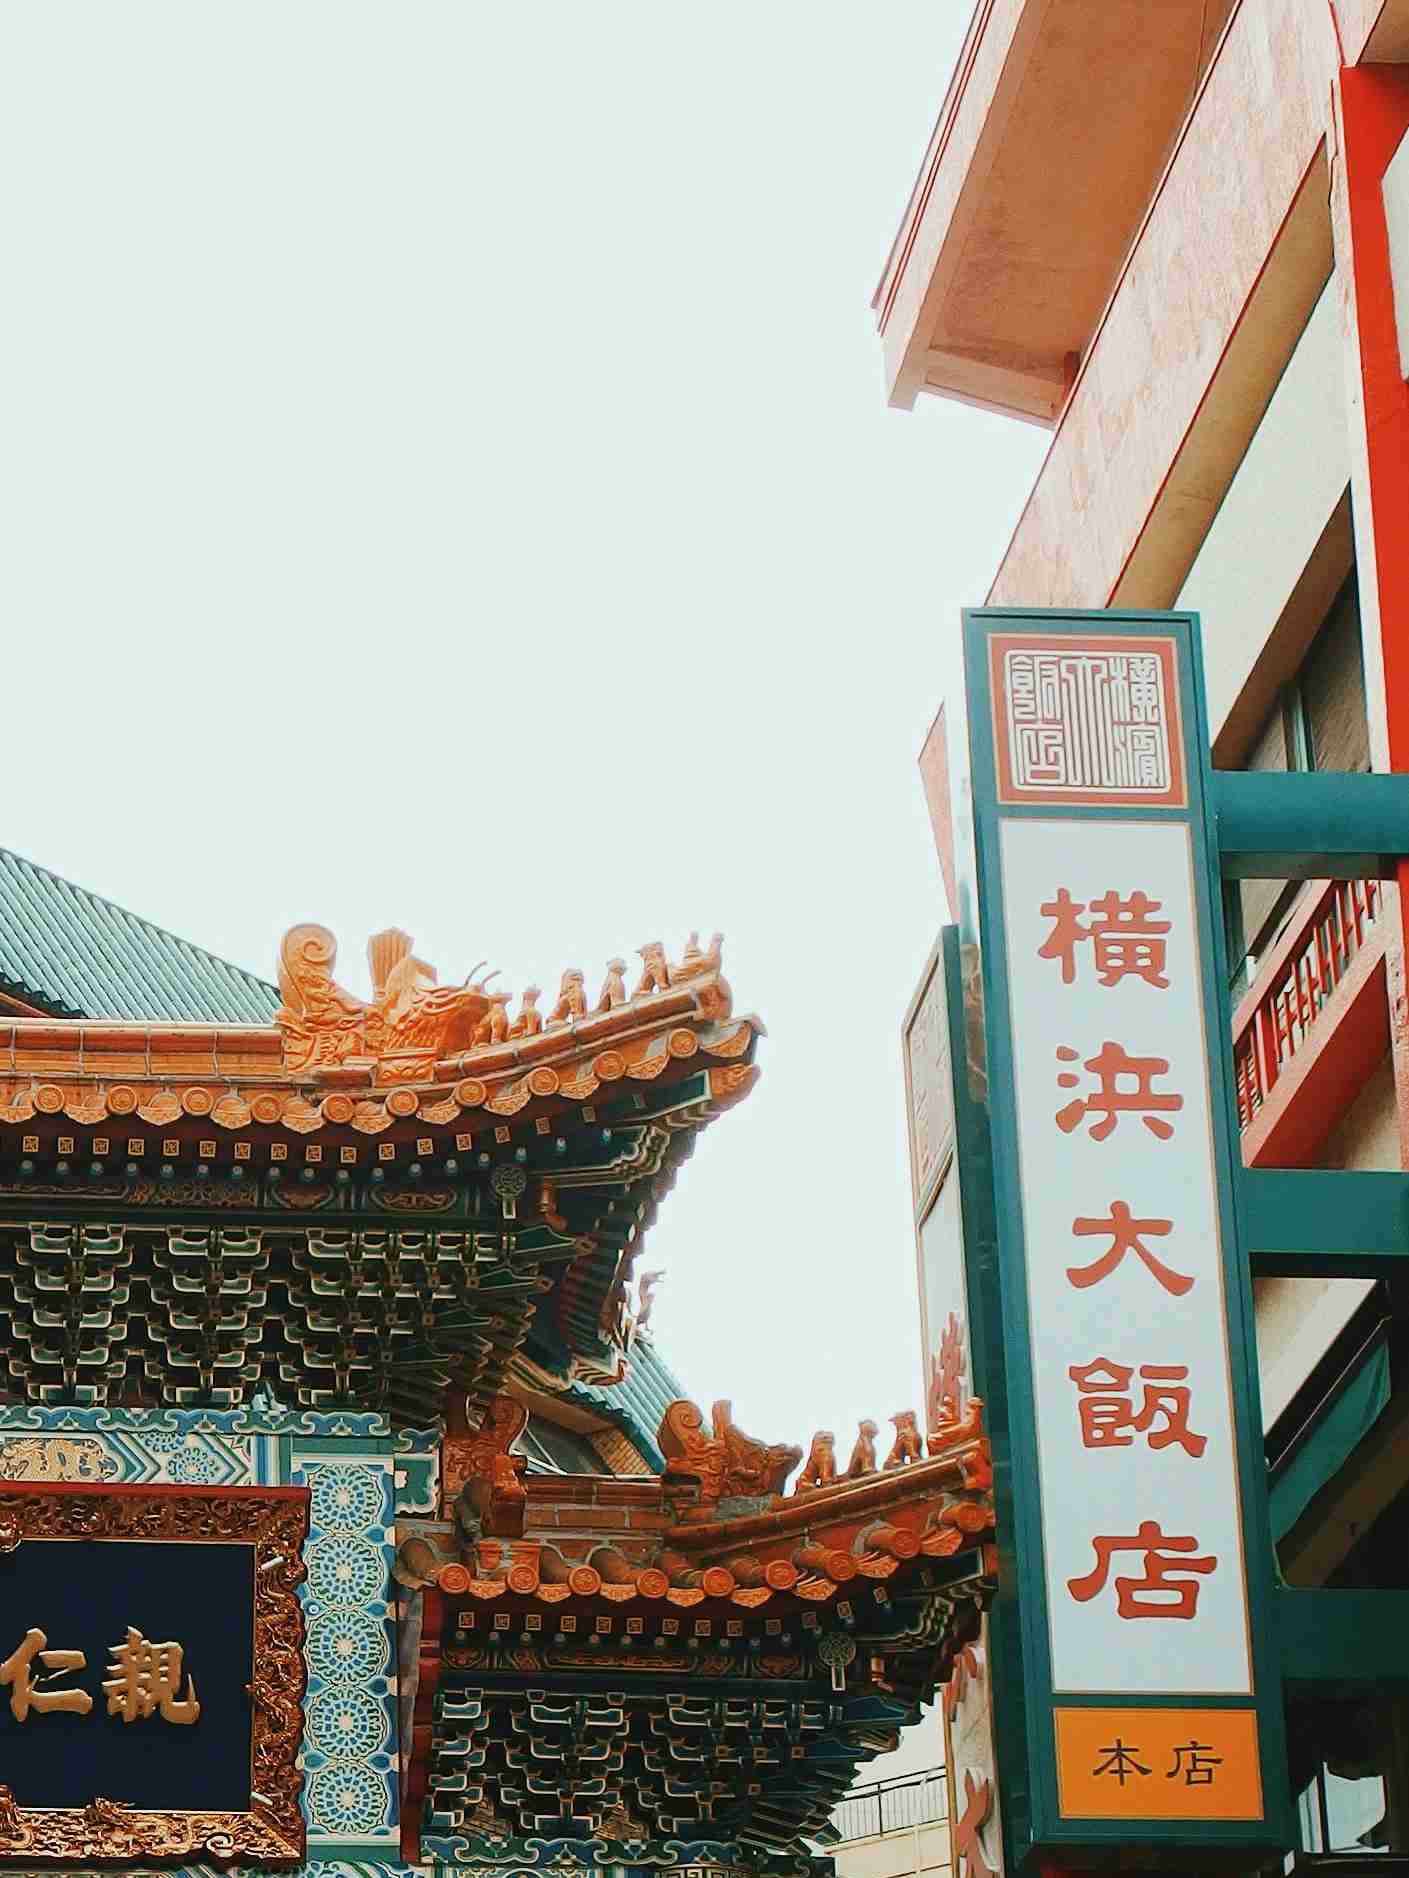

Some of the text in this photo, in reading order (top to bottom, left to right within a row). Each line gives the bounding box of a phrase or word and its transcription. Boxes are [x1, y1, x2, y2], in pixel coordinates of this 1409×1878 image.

[1038, 888, 1218, 1621] 横浜大飯店
[1092, 1739, 1225, 1787] 本店
